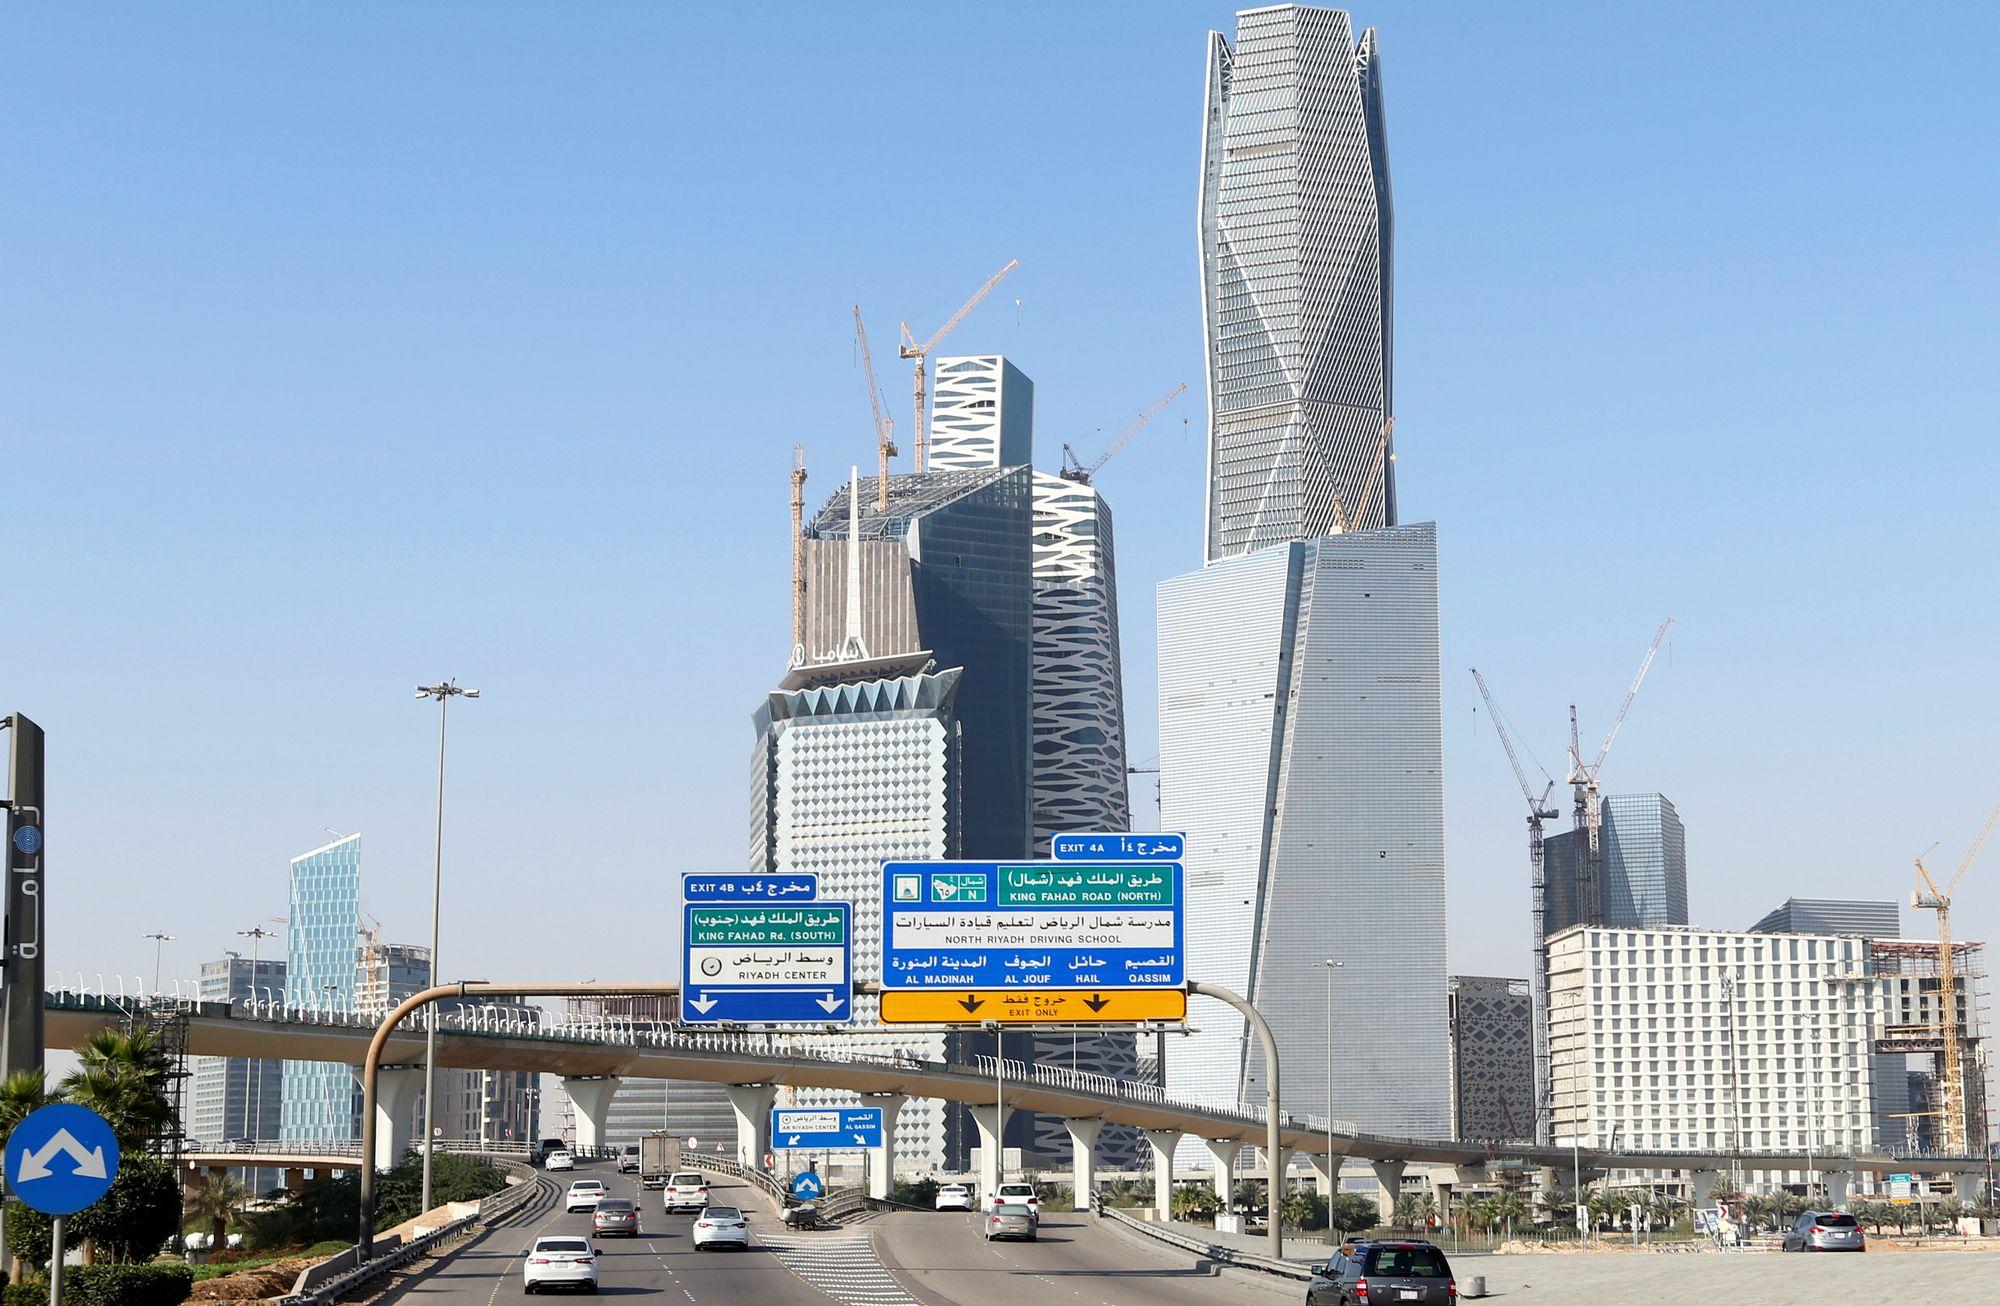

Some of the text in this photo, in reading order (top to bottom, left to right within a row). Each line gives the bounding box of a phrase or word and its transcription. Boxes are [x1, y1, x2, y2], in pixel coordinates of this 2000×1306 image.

[1060, 843, 1105, 852] EXIT 4A
[1137, 841, 1177, 855] مخرج
[960, 877, 984, 887] شمال
[1008, 870, 1163, 888] طريق الملك فهد (شمال)
[690, 883, 735, 893] EXIT 4B
[767, 881, 810, 896] مخرج
[968, 890, 977, 900] N
[1010, 891, 1162, 902] KING FAHAD ROAD (NORTH)
[694, 912, 840, 927] طريق الملك فهد (جنوب)
[895, 915, 1171, 931] مدرسة شمال الرياض لتعليم قيادة السيارات
[698, 931, 836, 941] KING FAHAD Rd. (SOUTH)
[945, 935, 1122, 944] NORTH RIYADH DRIVING SCHOOL
[732, 952, 833, 967] وسط الرياض
[892, 956, 987, 971] المدينة المنورة
[1004, 954, 1051, 970] الجوف
[1068, 955, 1107, 970] حائل
[1125, 954, 1175, 970] القصيم
[738, 971, 827, 980] RIYADH CENTER
[905, 974, 974, 984] AL MADINAH
[1004, 974, 1051, 984] AL JOUF
[1075, 974, 1100, 983] HAIL
[1128, 974, 1171, 983] QASSIM
[1002, 993, 1066, 1006] خروج فقط
[1009, 1008, 1058, 1017] EXIT ONLY
